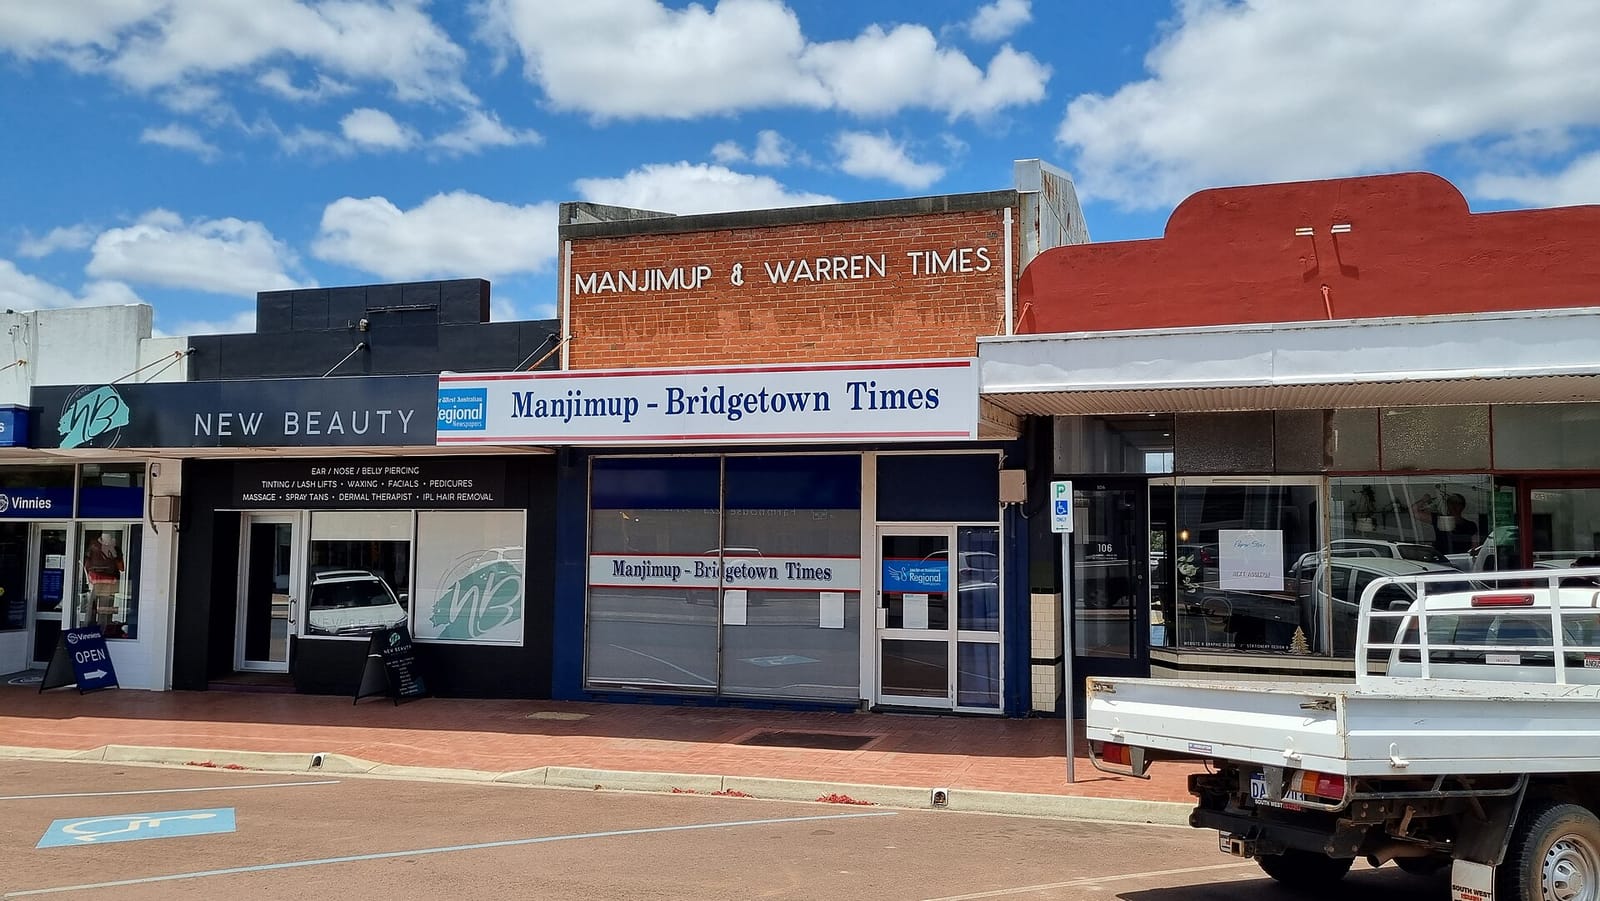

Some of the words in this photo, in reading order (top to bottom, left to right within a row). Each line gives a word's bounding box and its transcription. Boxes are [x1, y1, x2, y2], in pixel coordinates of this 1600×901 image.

[575, 265, 713, 295] MANJIMUP
[730, 262, 745, 287] &
[764, 253, 887, 284] WARREN
[906, 246, 992, 275] TIMES
[510, 389, 640, 424] Manjimup
[664, 385, 831, 422] Bridgetown
[846, 380, 940, 412] Times
[438, 402, 483, 424] egional
[194, 411, 264, 436] NEW
[283, 408, 415, 435] BEAUTY
[311, 467, 326, 475] EAR
[333, 467, 355, 475] NOSE
[361, 466, 383, 475] BELLY
[384, 466, 420, 475] PIERCING
[261, 480, 290, 488] TINTING
[296, 480, 316, 488] LASH
[317, 480, 338, 488] LIFTS
[347, 480, 378, 488] WAXING
[388, 480, 419, 488] FACIALS
[429, 479, 473, 488] PEDICURES
[242, 493, 276, 501] MASSAGE
[285, 493, 307, 501] SPRAY
[309, 493, 329, 501] TANS
[338, 493, 370, 501] DERMAL
[371, 492, 413, 501] THERAPIST
[422, 492, 435, 500] IPL
[436, 492, 456, 500] HAIR
[457, 492, 494, 501] REMOVAL
[1056, 484, 1066, 498] P
[11, 496, 52, 509] Vinnies
[1097, 543, 1113, 552] 106
[612, 559, 681, 581] Manjimup
[785, 562, 833, 581] Times
[909, 572, 941, 584] Regional
[77, 632, 101, 641] Vinnies
[75, 648, 106, 665] OPEN
[1452, 884, 1473, 894] SOUTH
[1473, 889, 1492, 899] WEST
